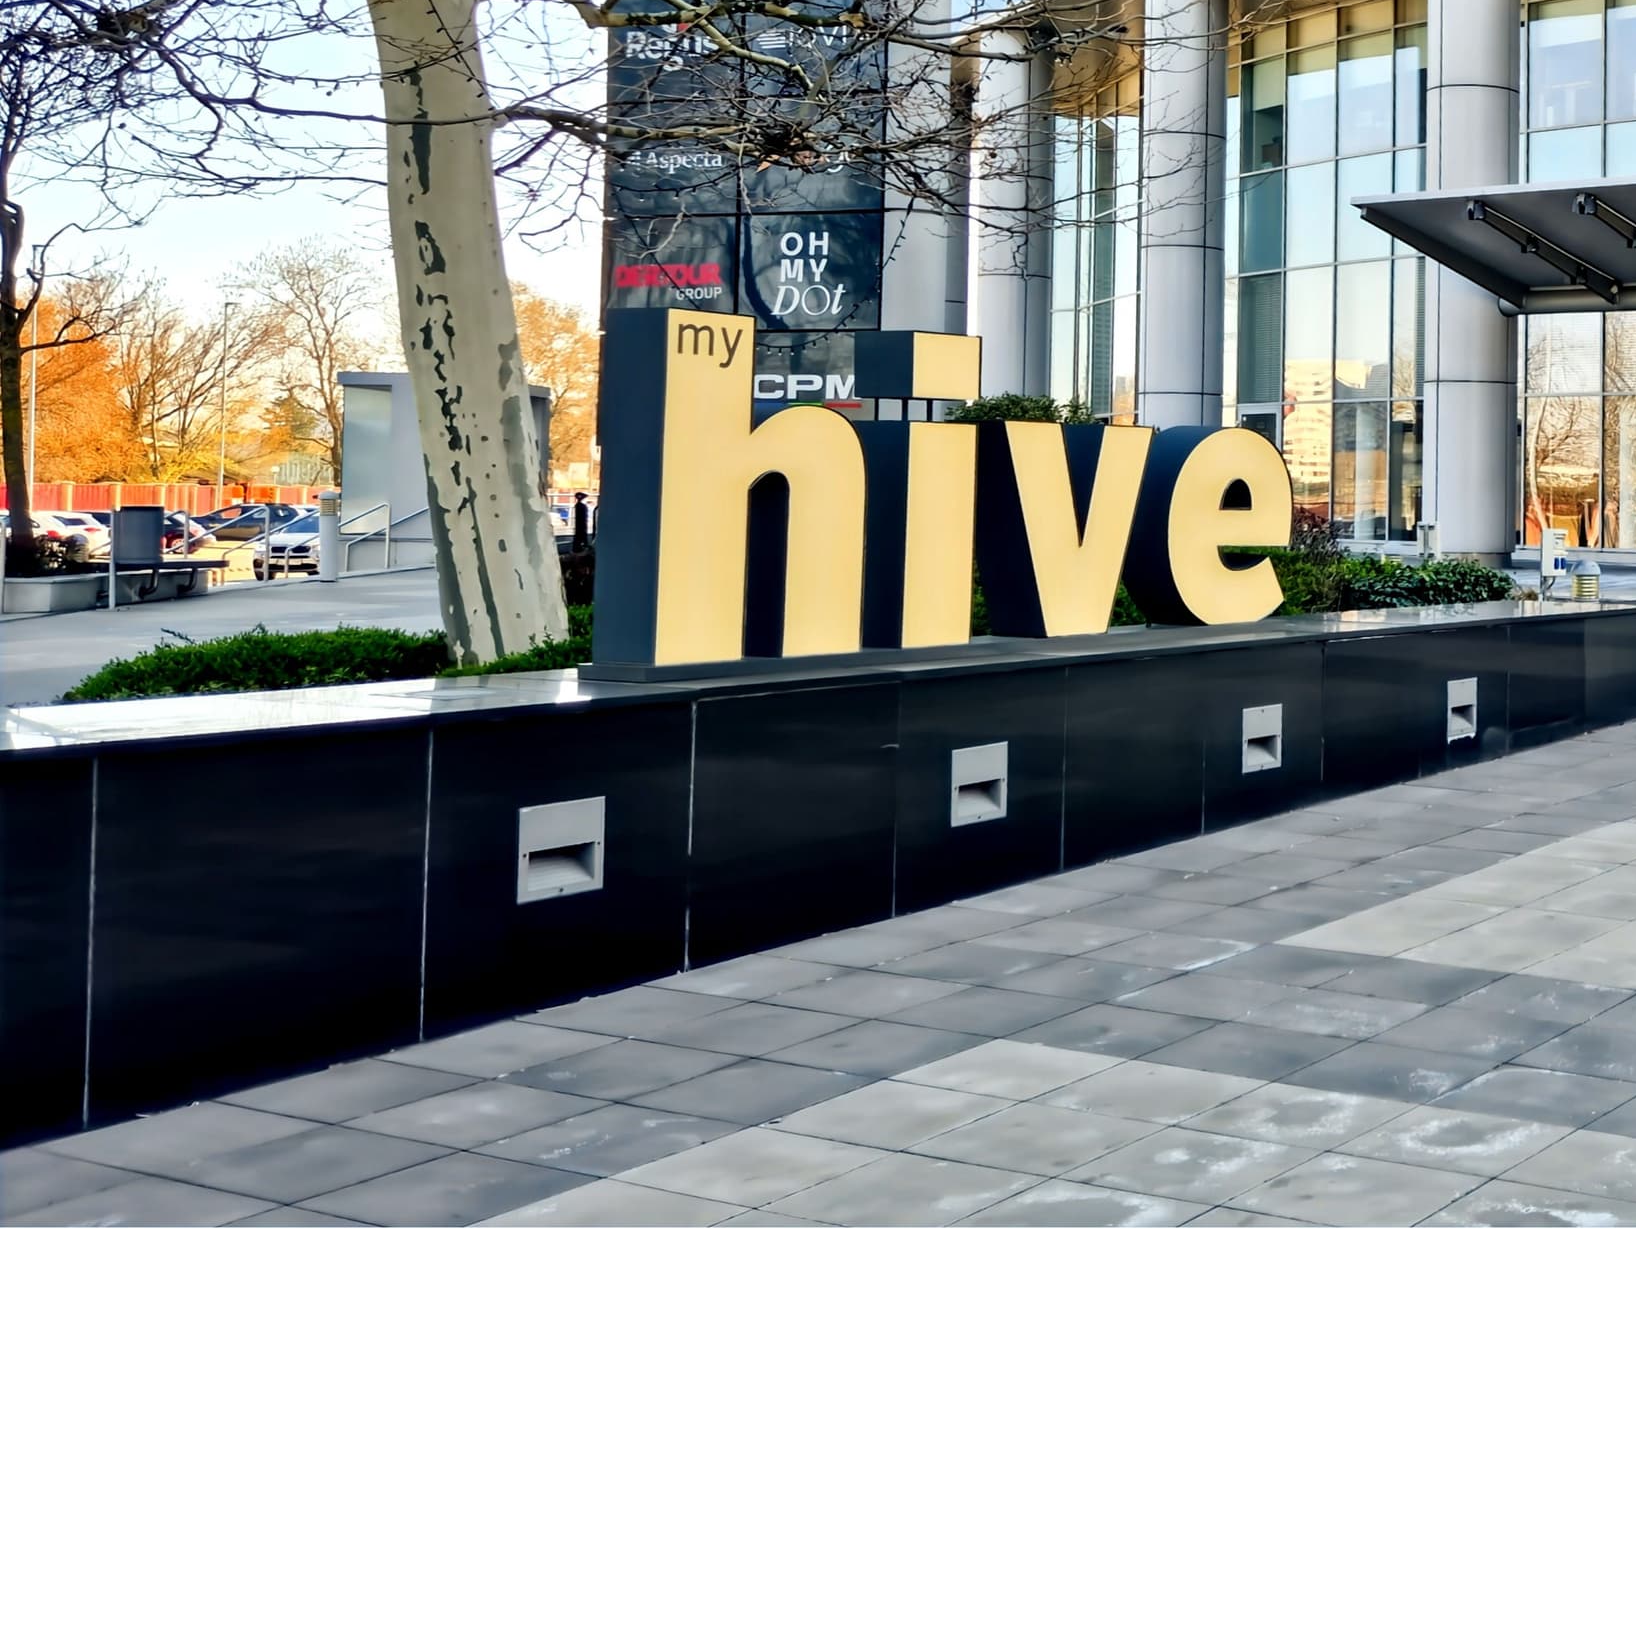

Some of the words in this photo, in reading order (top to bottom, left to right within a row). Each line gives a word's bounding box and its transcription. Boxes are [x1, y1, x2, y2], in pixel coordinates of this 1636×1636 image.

[625, 31, 721, 72] Regus
[646, 151, 723, 174] Aspecta
[780, 231, 829, 257] OH
[780, 258, 828, 283] MY
[675, 286, 722, 301] GROUP
[677, 322, 744, 369] my
[752, 373, 863, 400] CPM
[654, 307, 1294, 666] hive
